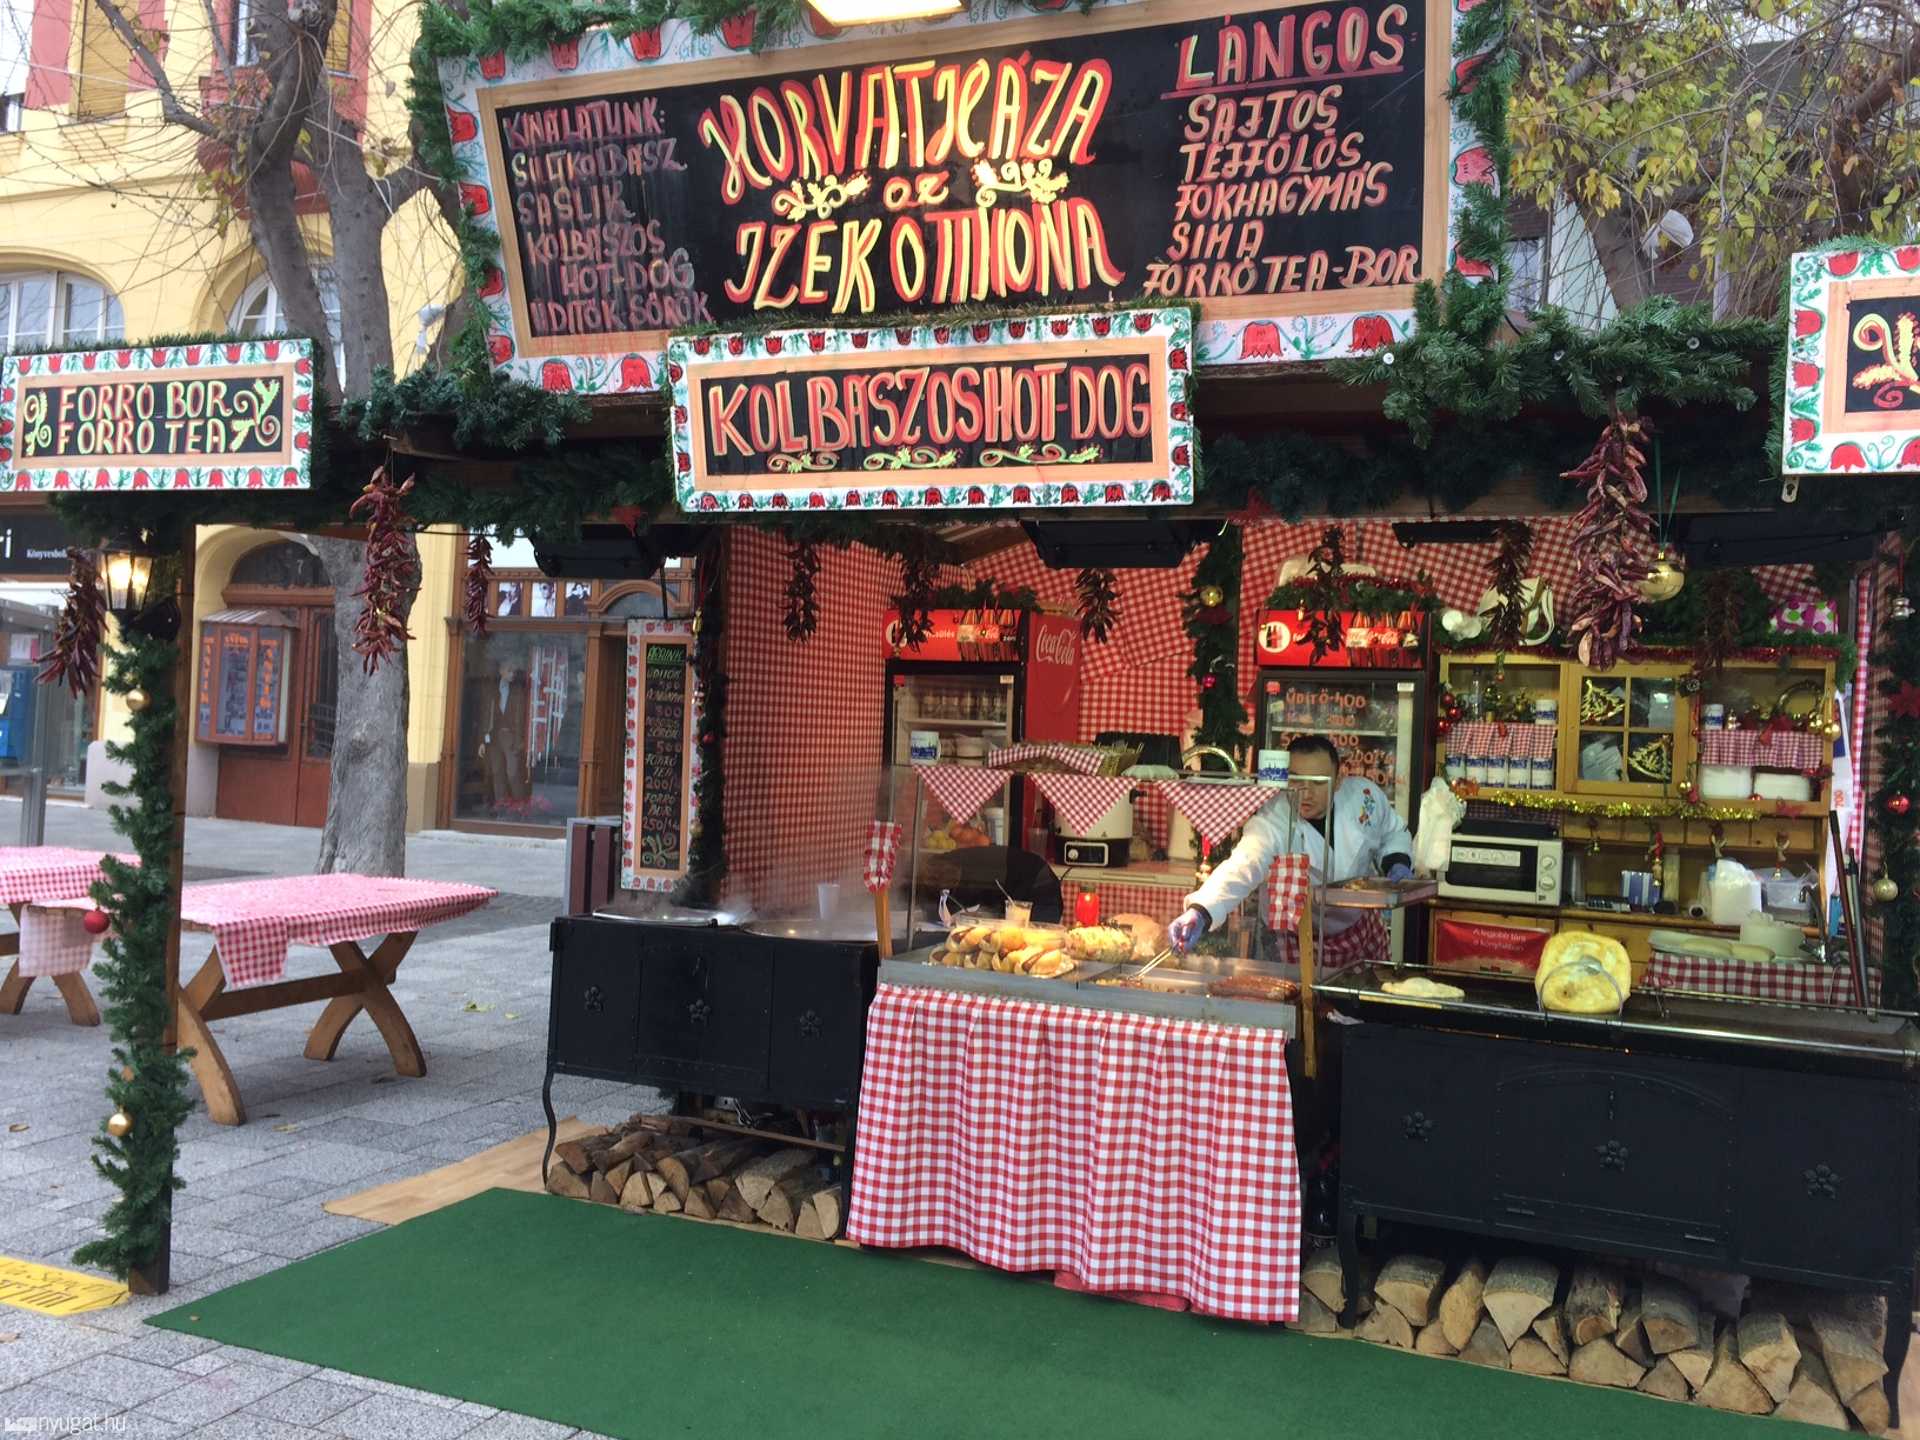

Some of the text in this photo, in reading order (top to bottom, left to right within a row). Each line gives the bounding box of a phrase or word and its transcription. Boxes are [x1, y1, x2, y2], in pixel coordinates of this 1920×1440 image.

[1184, 84, 1343, 143] SAJTOS
[1167, 220, 1264, 261] SIMA
[166, 380, 233, 419] BOR
[984, 362, 1151, 443] HOT-DOG
[165, 418, 226, 453] TEA
